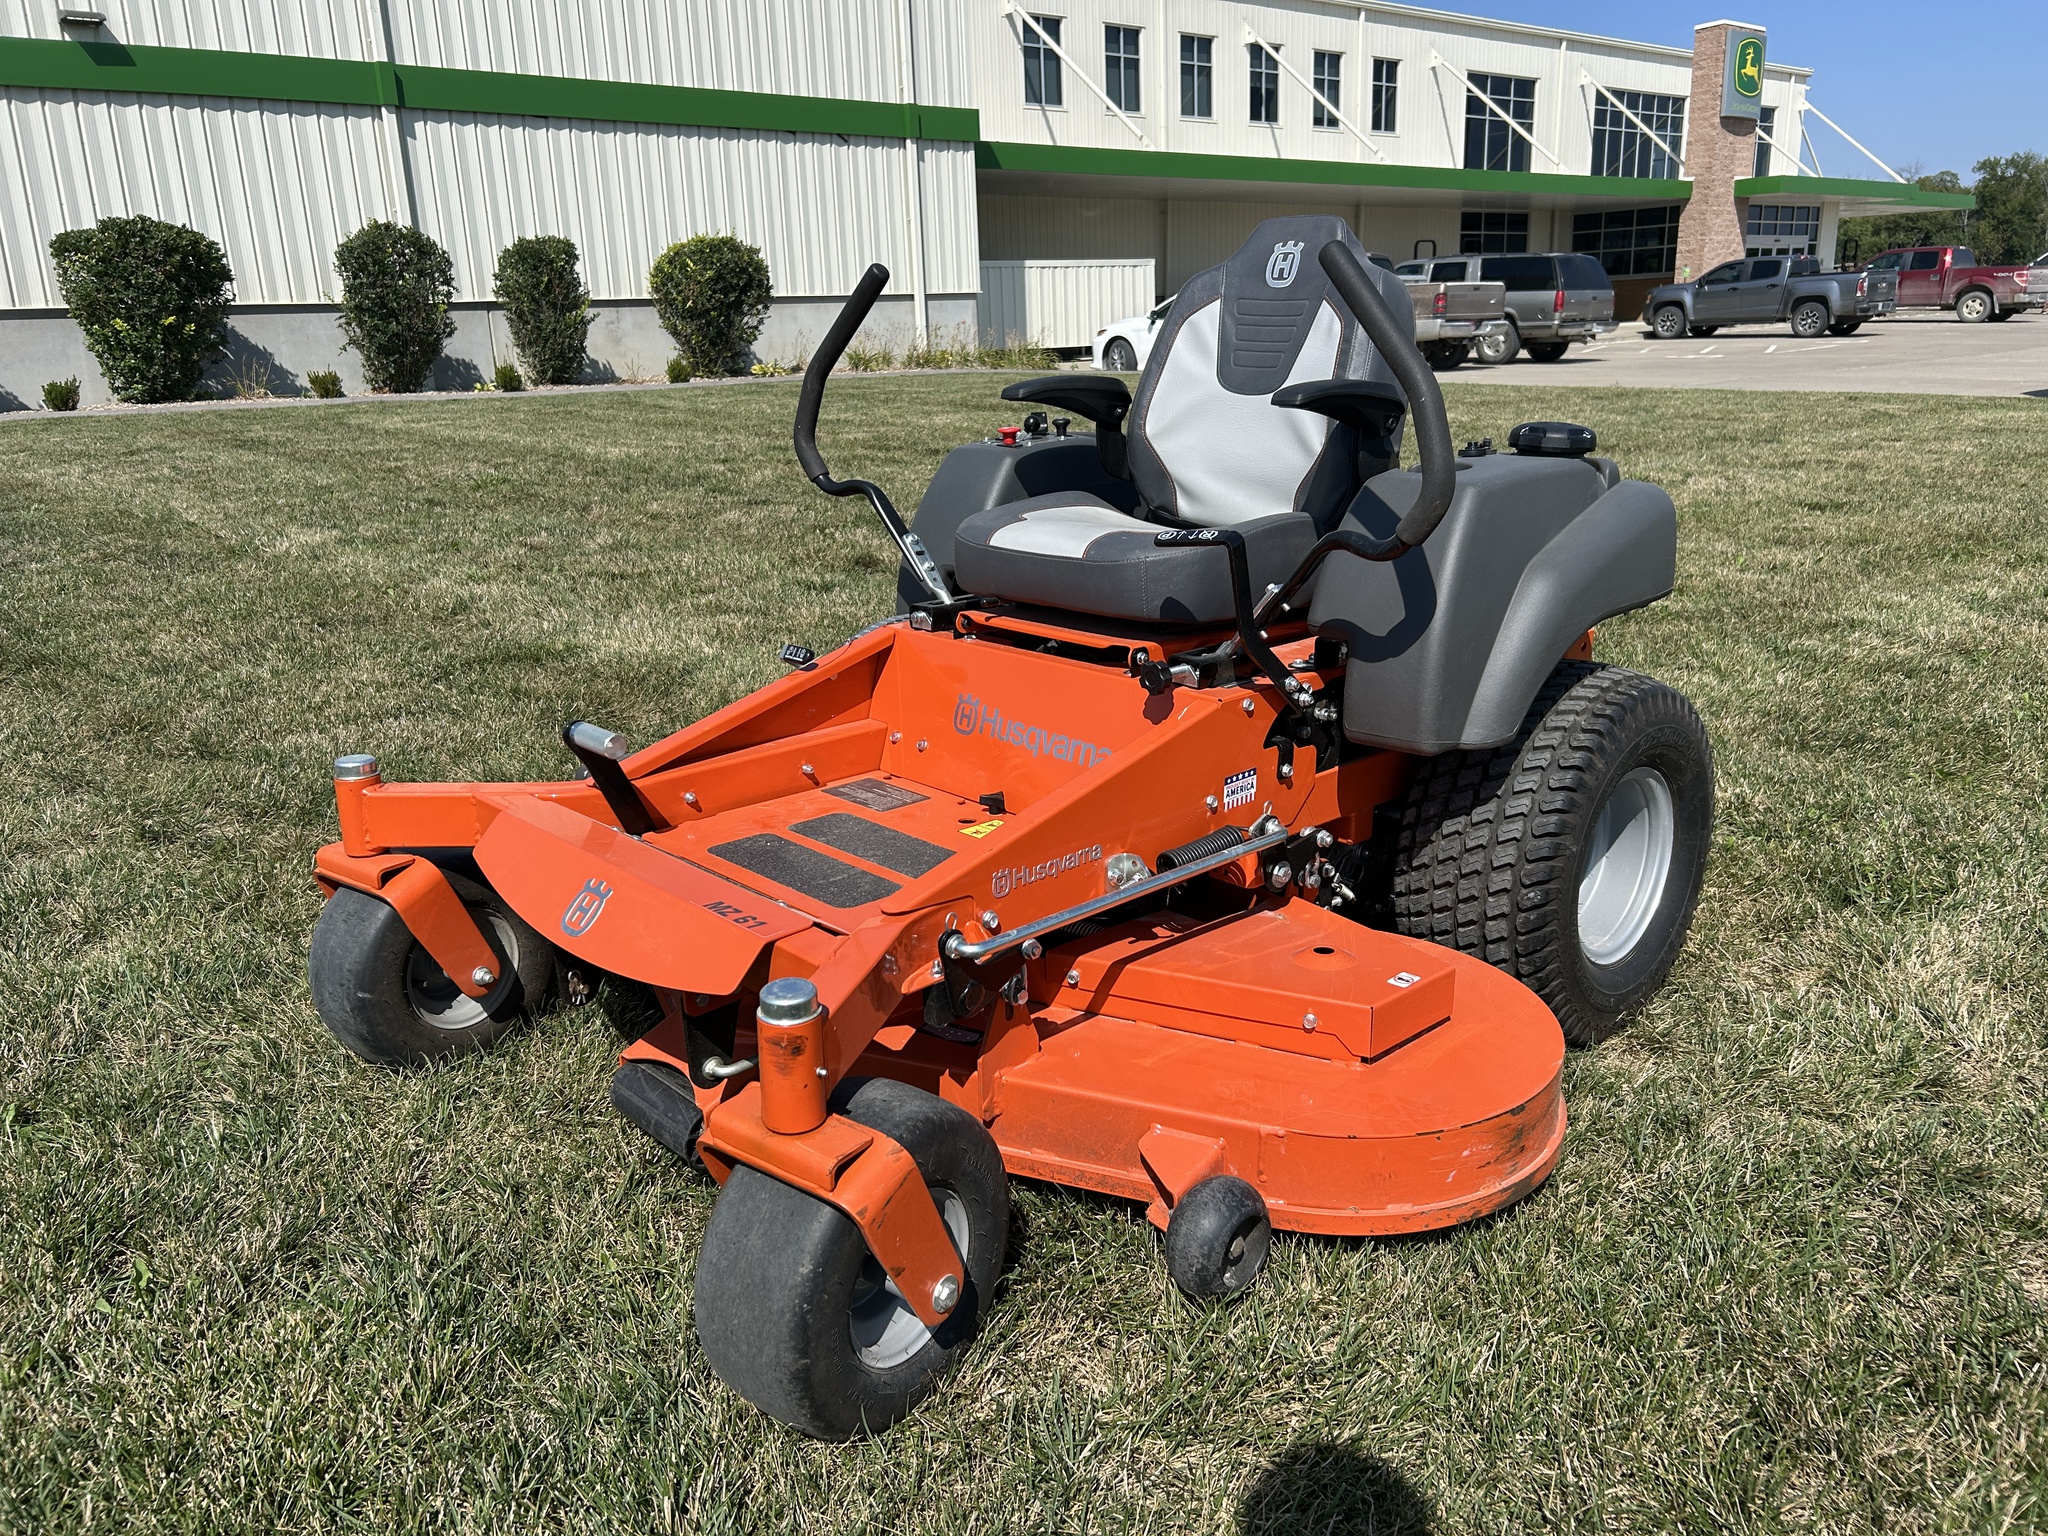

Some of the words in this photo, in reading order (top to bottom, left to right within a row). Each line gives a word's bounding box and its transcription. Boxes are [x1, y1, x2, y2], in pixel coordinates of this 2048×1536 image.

[1225, 781, 1254, 799] AMERICA
[1012, 843, 1102, 889] Husqvarna
[702, 901, 743, 917] MZ
[733, 915, 768, 929] 61
